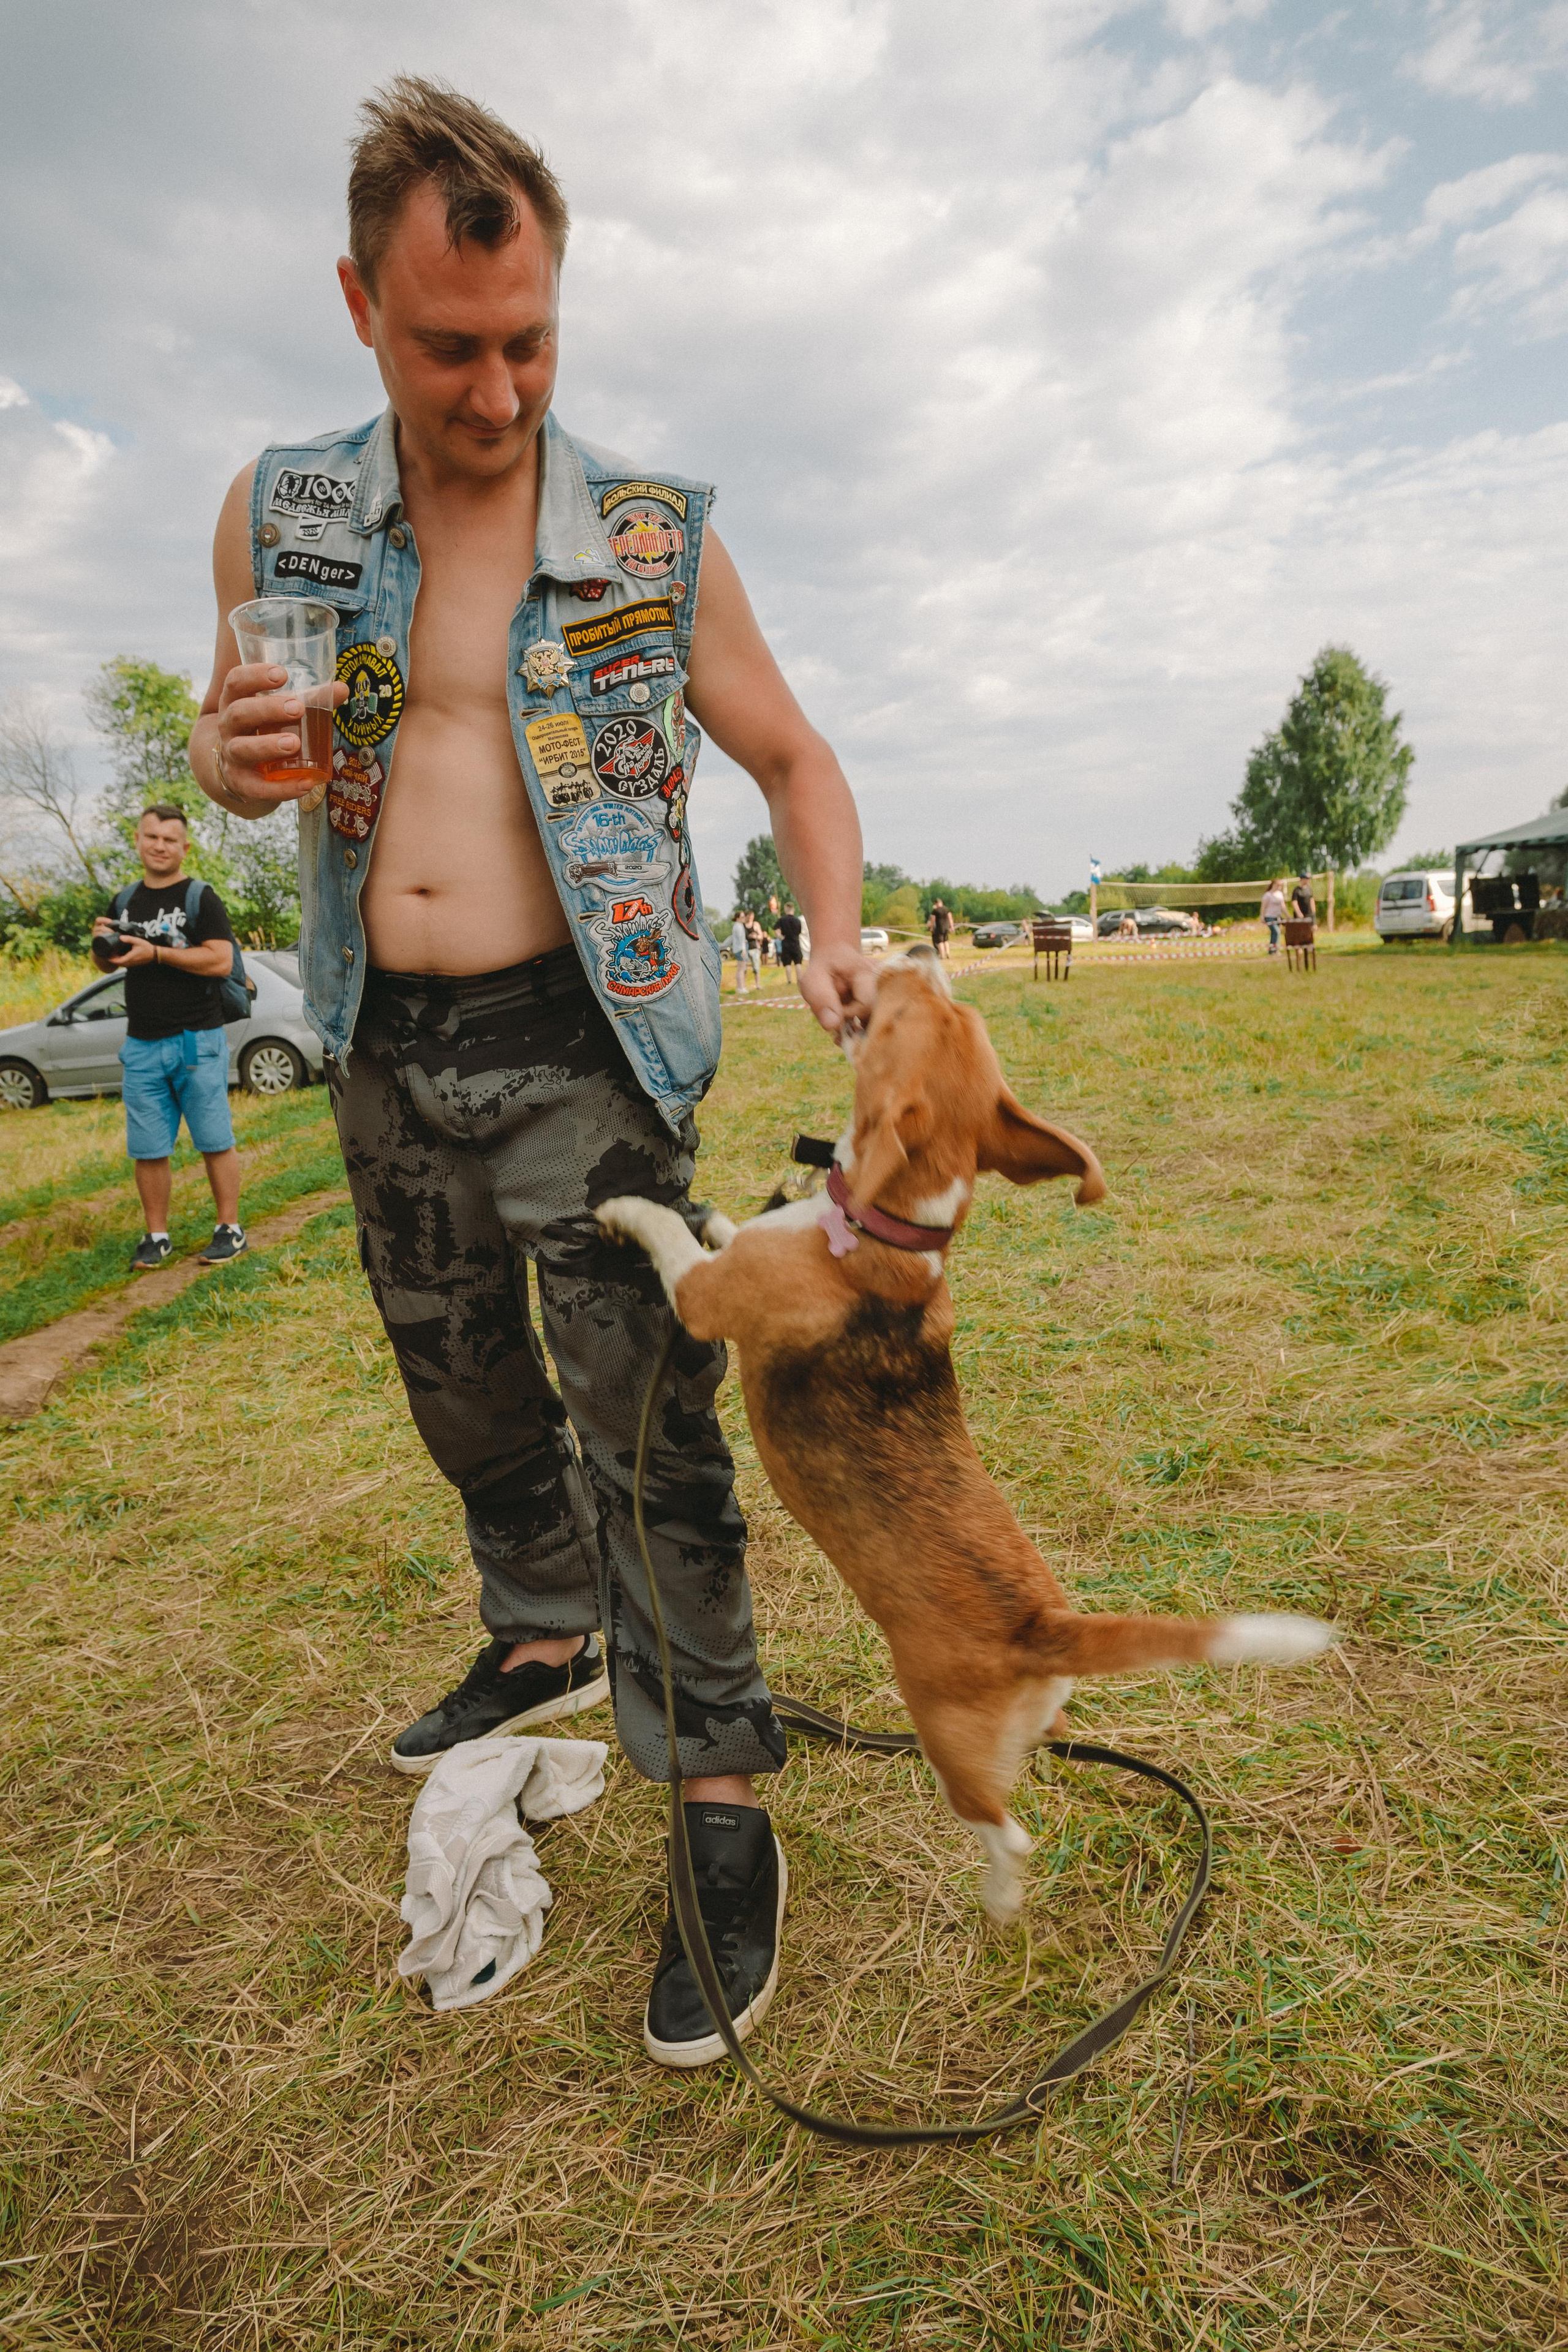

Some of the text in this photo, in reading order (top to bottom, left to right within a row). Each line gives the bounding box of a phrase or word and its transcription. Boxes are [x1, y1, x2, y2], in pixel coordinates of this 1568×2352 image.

[605, 484, 683, 510] ВОЛЬСКИЙ ФИЛИАЛ
[608, 529, 684, 557] ЕРЕДИНА ЛЕТА
[568, 607, 671, 647] ПРОБИТЫЙ ПРЯМОТОК
[338, 654, 388, 683] МОТОКАРНАВАЛ
[594, 655, 640, 679] SUPER
[379, 684, 393, 698] 20
[348, 712, 385, 736] У БУЙНЫХ
[538, 722, 554, 732] 24-26
[538, 737, 581, 754] МОТО-ФЕСТ
[596, 720, 636, 757] 2020
[618, 748, 665, 797] СУЗДАЛЬ
[329, 793, 372, 817] FREE RIDERS
[576, 804, 603, 832] INTERNATIONAL
[624, 805, 650, 830] MOTORALLY
[592, 812, 626, 827] 16-th
[612, 897, 654, 924] 17th
[628, 901, 639, 917] 2021
[607, 962, 680, 997] САМАРСКАЯ ЛУКА
[705, 1815, 736, 1826] adidas
